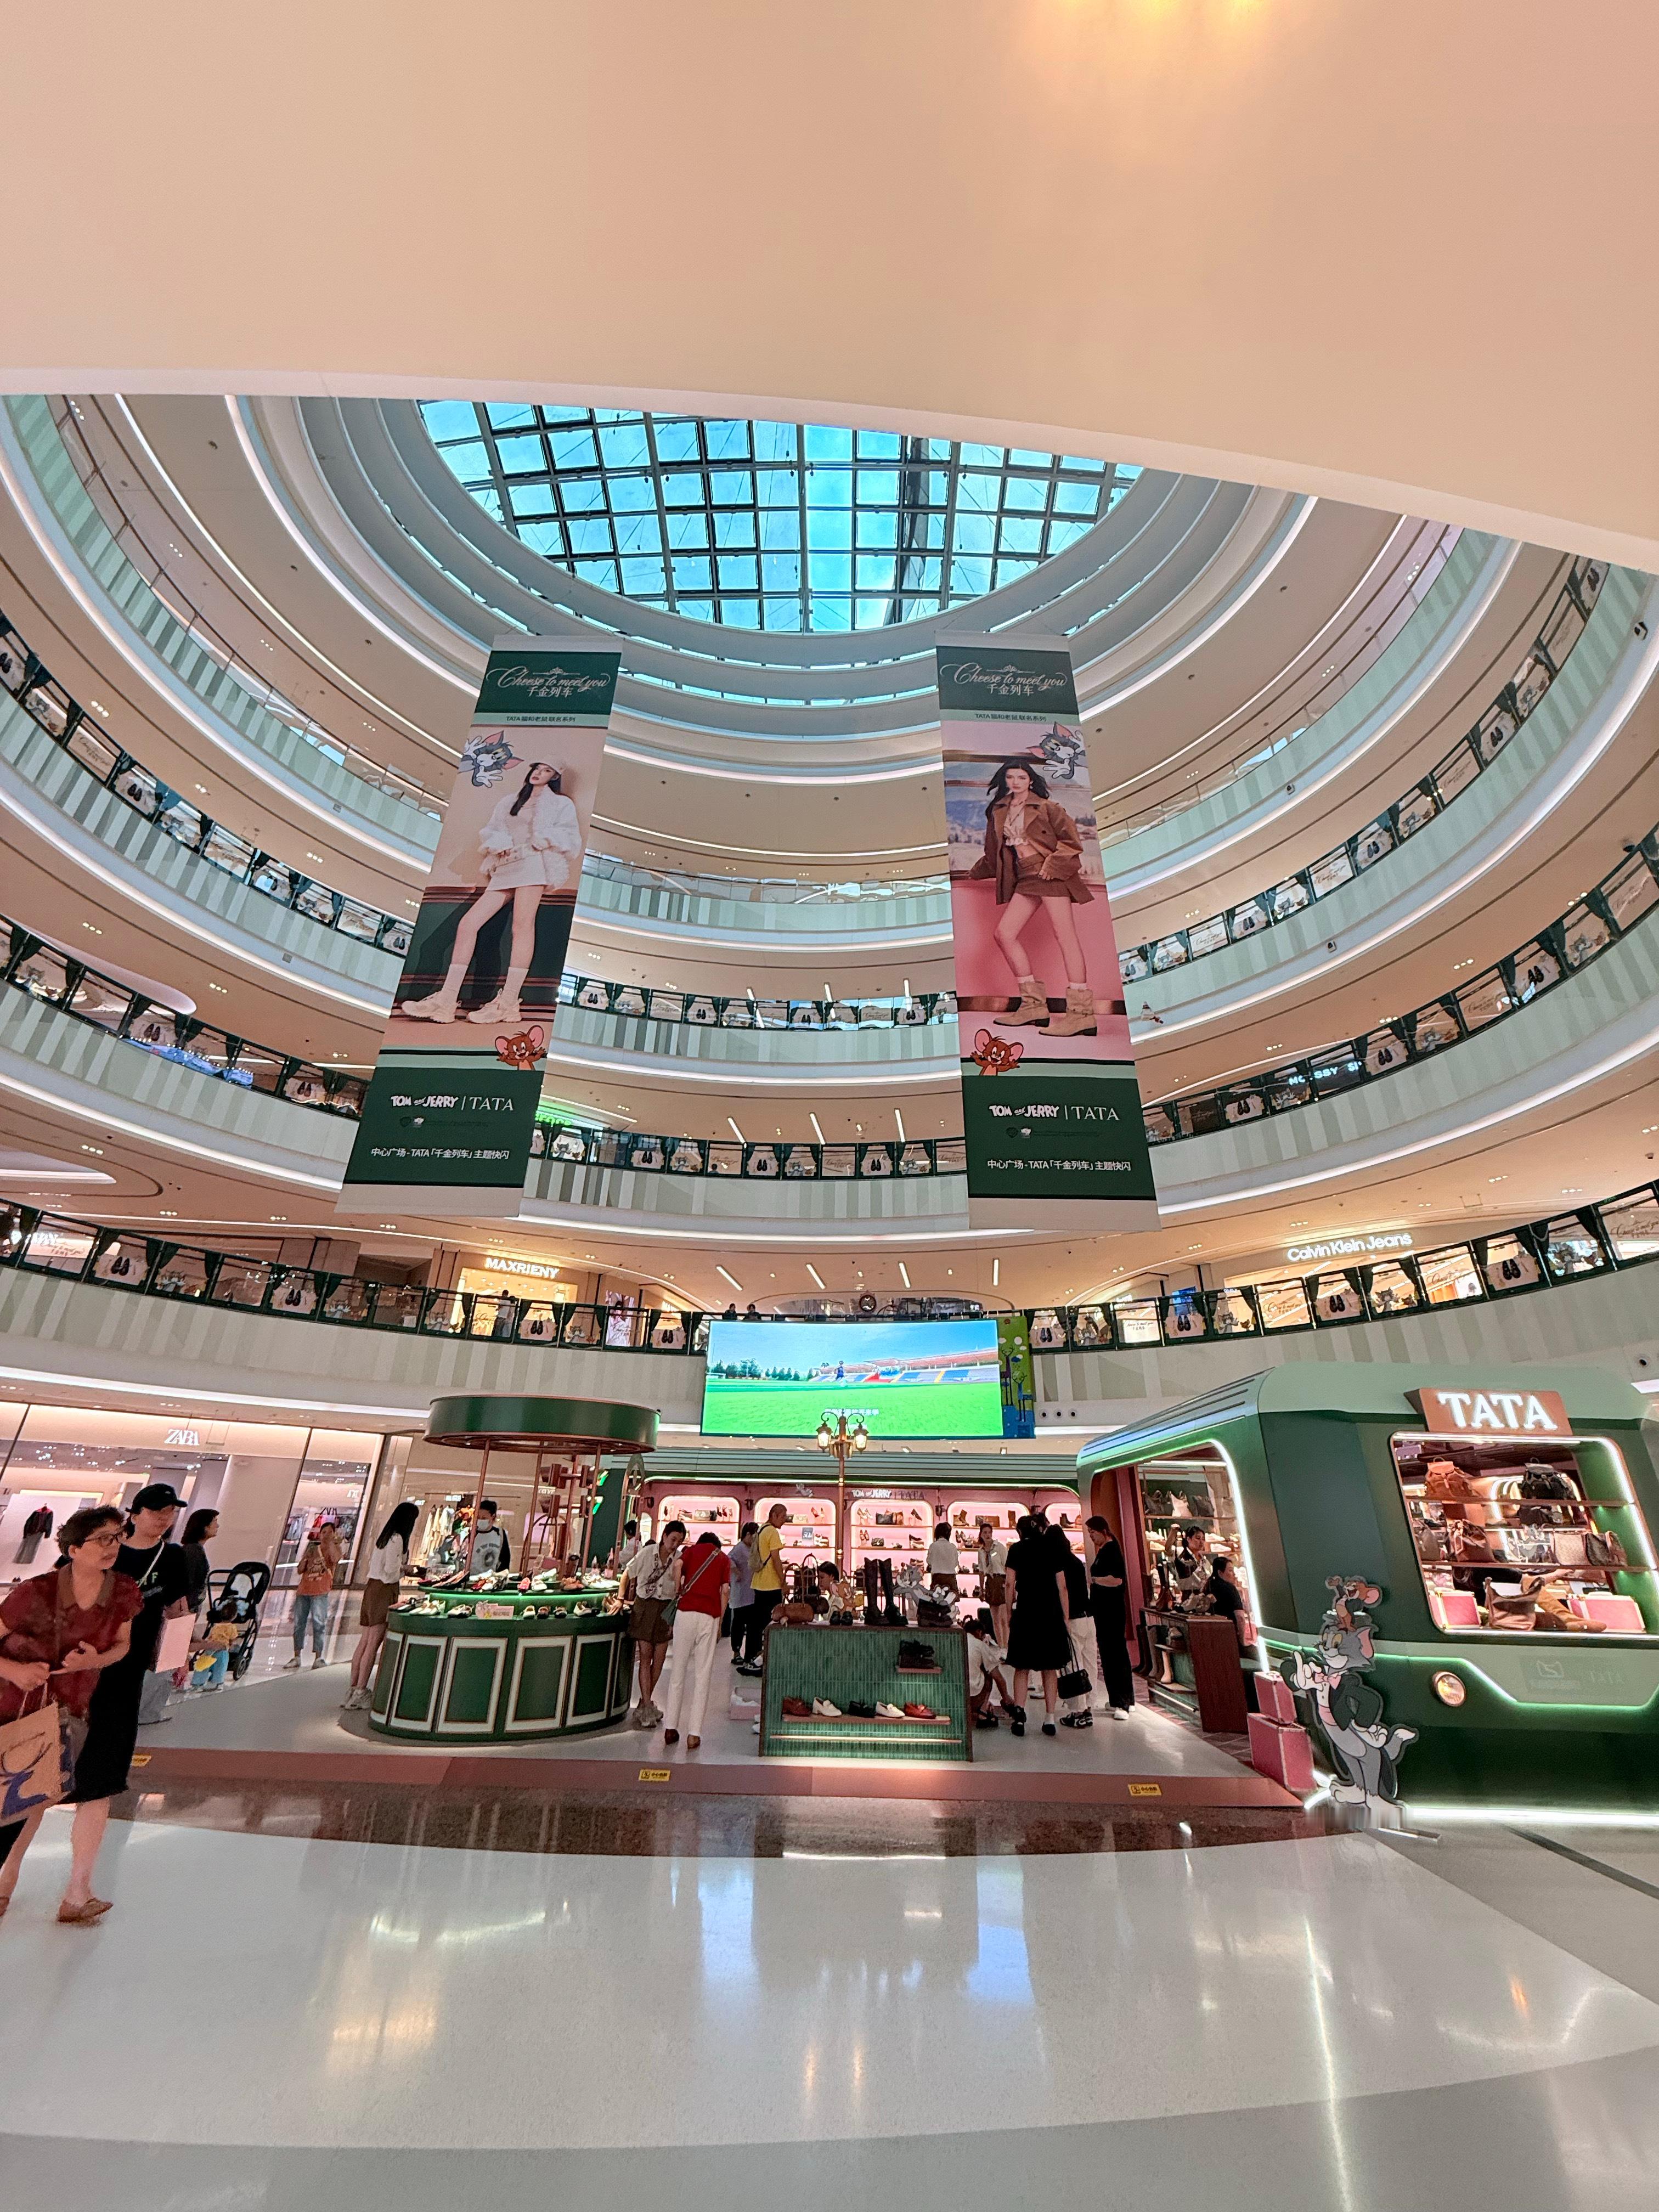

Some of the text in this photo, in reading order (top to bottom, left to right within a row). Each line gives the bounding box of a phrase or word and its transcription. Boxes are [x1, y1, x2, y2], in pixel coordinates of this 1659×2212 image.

[486, 666, 611, 692] Cheese to meet you
[940, 663, 1068, 691] Cheese to meet you
[527, 686, 573, 698] 千金列车
[988, 684, 1034, 696] 千金列车
[391, 1095, 514, 1111] TOM and JERRY TATA
[989, 1105, 1120, 1120] TOM and JERRY TATA
[1287, 1233, 1413, 1261] Calvin Klein Jeans
[485, 1257, 560, 1279] MAXRIENY
[1437, 1391, 1558, 1431] TATA
[871, 1489, 892, 1498] JERRY
